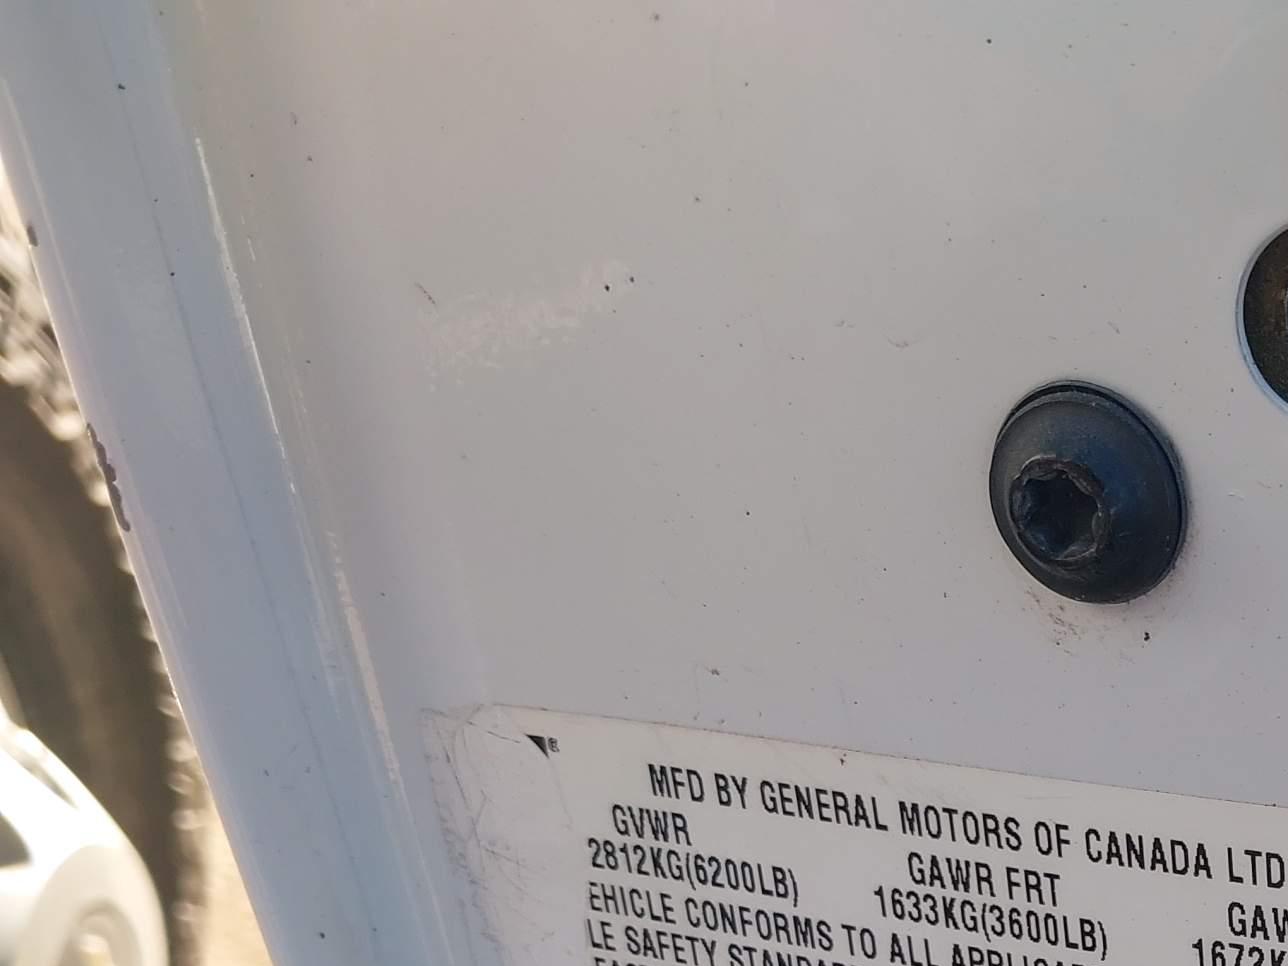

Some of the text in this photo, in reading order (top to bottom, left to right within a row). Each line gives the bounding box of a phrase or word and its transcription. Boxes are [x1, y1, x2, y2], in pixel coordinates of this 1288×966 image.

[612, 804, 692, 846] GVWR
[648, 763, 705, 803] MFD
[714, 772, 748, 809] BY
[760, 780, 888, 831] GENERAL
[898, 800, 1022, 851] MOTORS
[1034, 821, 1071, 858] OF
[1085, 828, 1213, 879] CANADA
[587, 837, 798, 908] 2812KG(6200LB)
[907, 851, 1060, 907] GAWR FRT
[684, 897, 834, 952] CONFORMS
[841, 923, 877, 959] TO
[873, 885, 1107, 961] 1633KG(3600LB)
